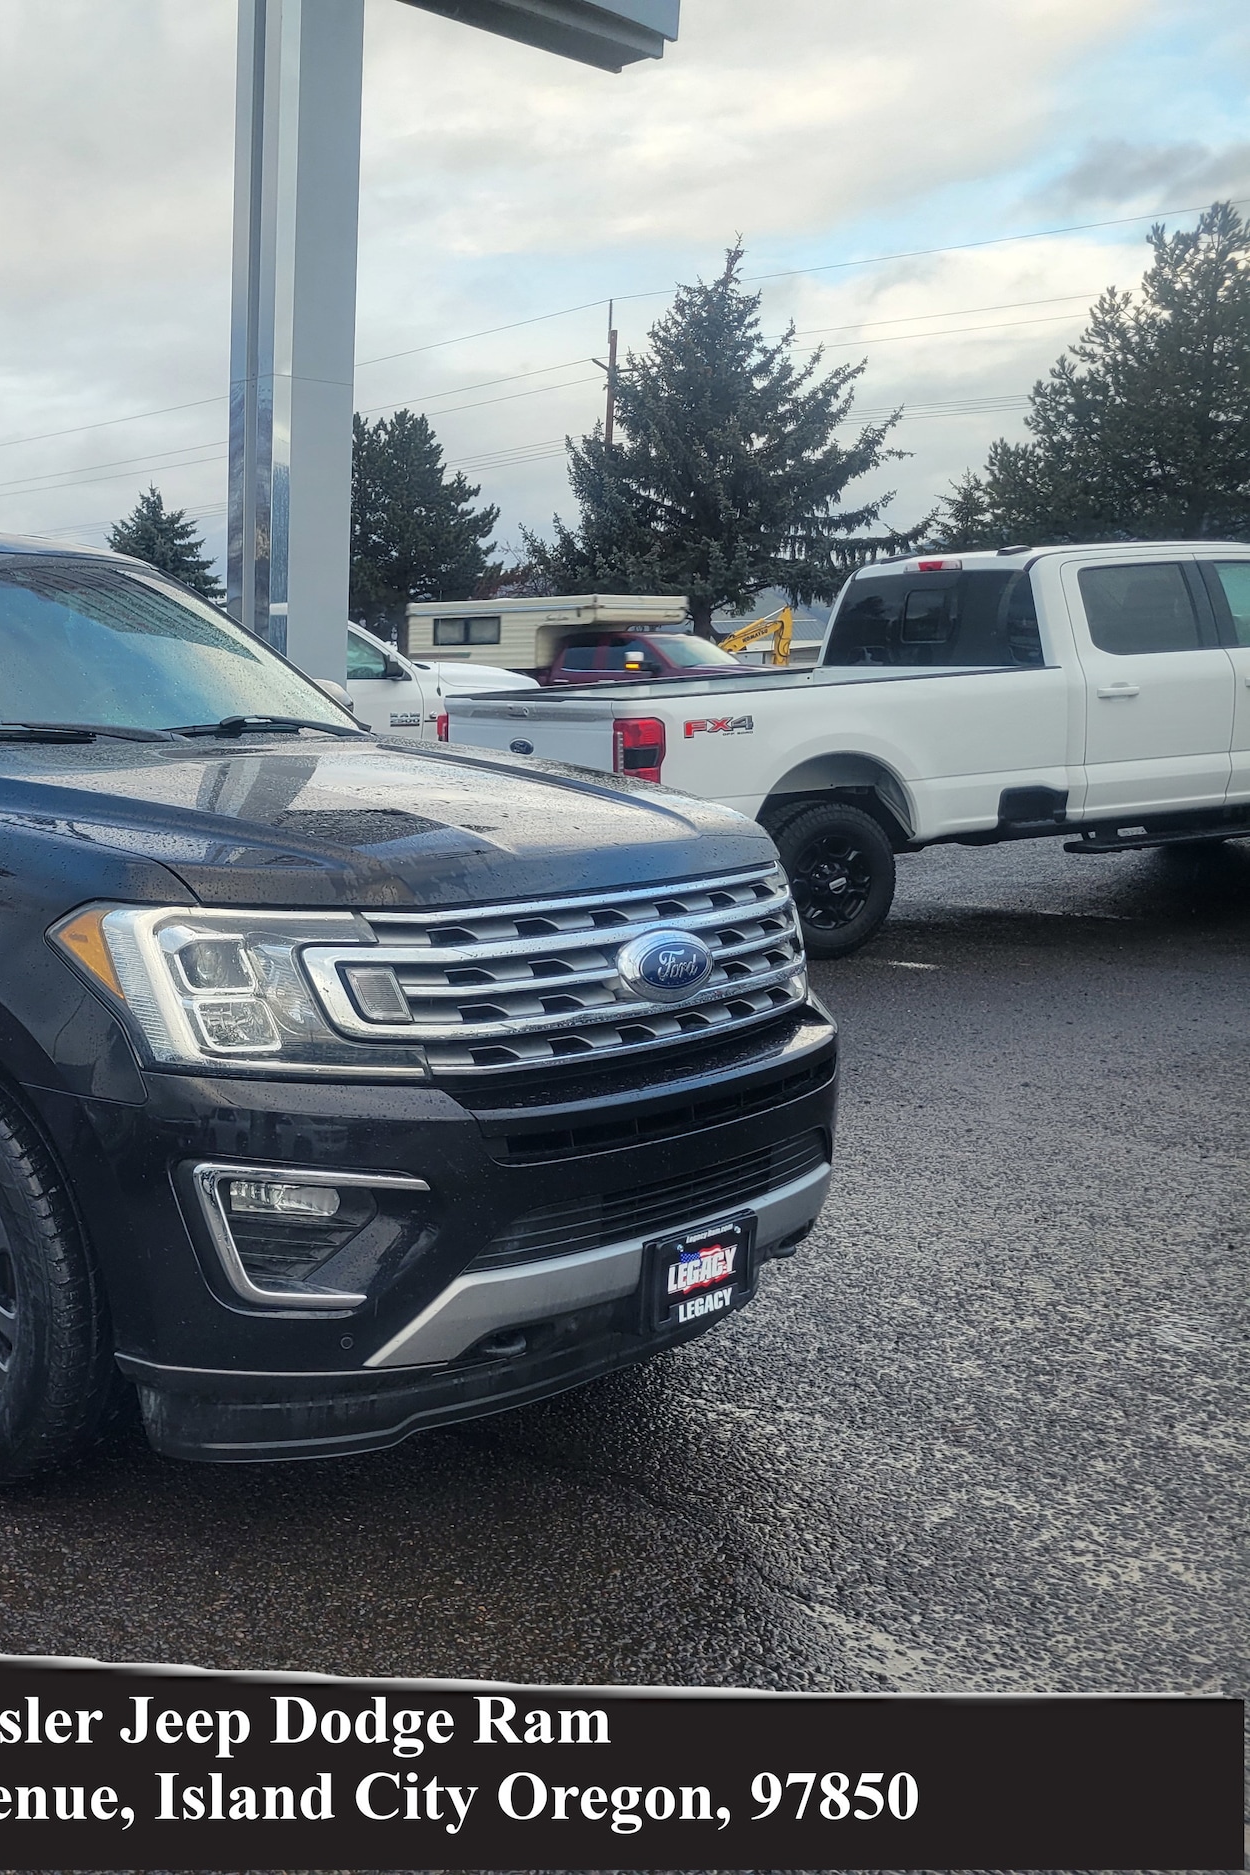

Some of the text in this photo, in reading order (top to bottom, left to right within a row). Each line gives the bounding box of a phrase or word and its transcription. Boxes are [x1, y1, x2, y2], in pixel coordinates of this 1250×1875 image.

[742, 628, 769, 643] KOMATSU
[683, 715, 754, 738] FX4
[657, 949, 699, 981] Ford
[667, 1246, 737, 1292] LEGACY
[678, 1287, 733, 1323] LEGACY
